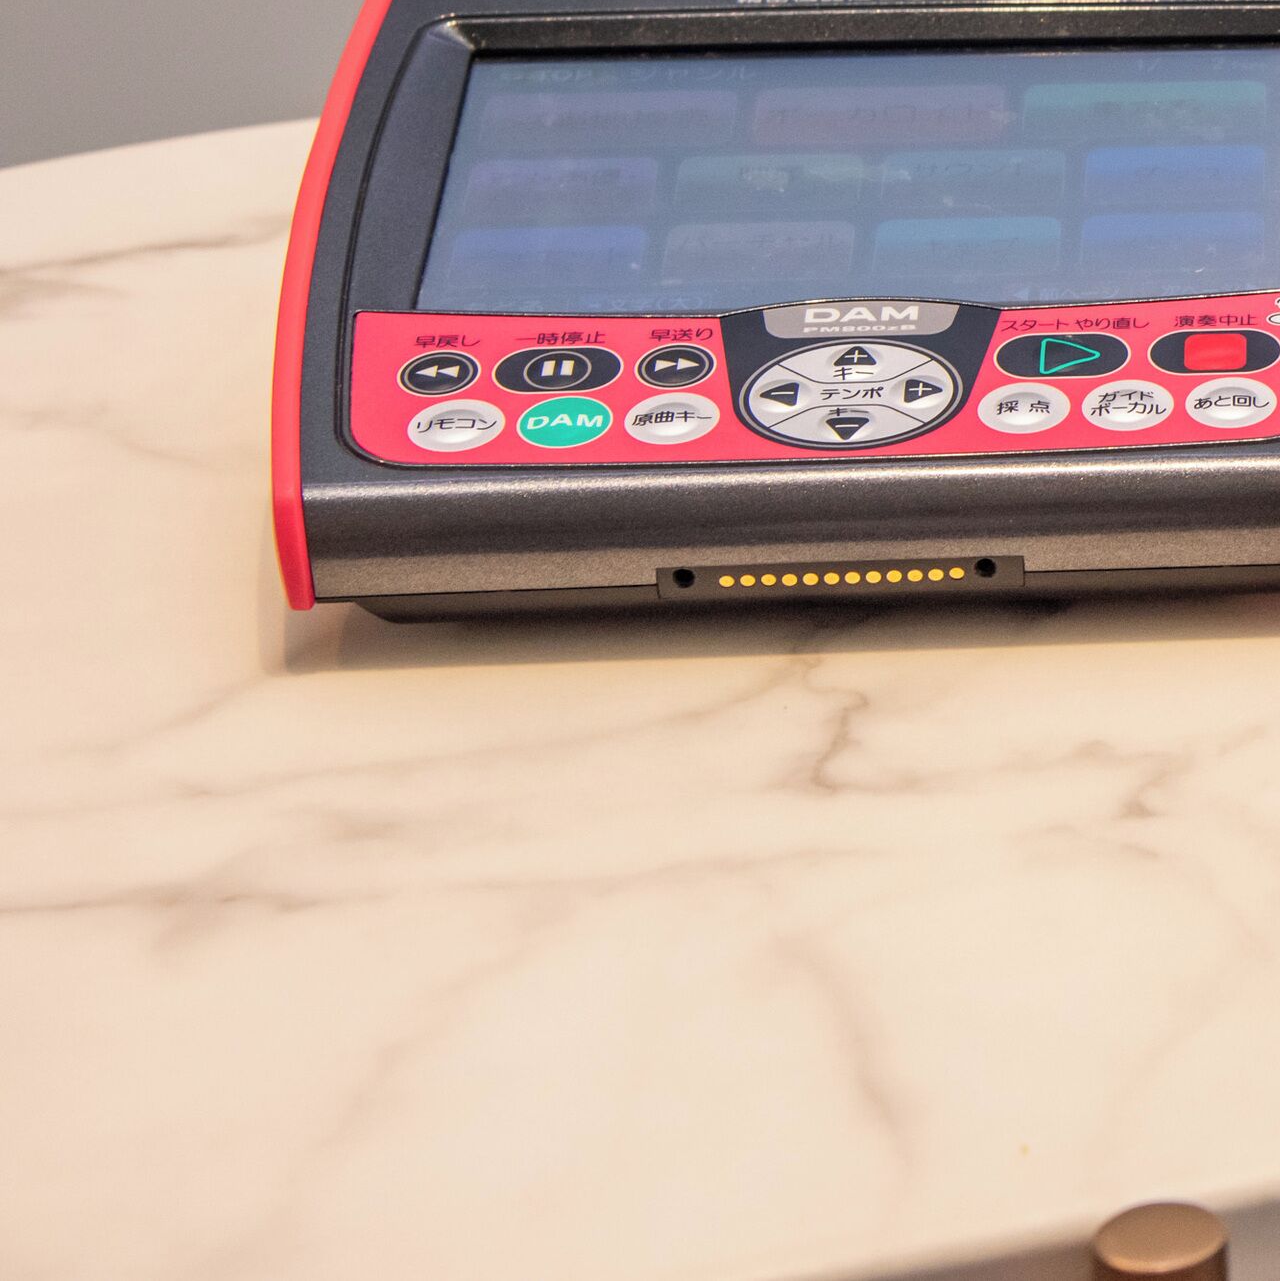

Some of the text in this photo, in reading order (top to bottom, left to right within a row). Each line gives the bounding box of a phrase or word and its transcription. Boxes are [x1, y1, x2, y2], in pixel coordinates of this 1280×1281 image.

[803, 305, 920, 324] DAM
[1174, 315, 1258, 328] 演奏中止
[1001, 317, 1151, 331] スタート やり直し
[414, 334, 481, 349] 早戻し
[515, 331, 607, 346] 一時停止
[648, 326, 714, 342] 早送り
[832, 366, 875, 381] キー
[820, 386, 884, 401] テンポ
[1098, 390, 1155, 402] ガイド
[1193, 393, 1270, 409] あと回し
[1090, 401, 1167, 416] ボーカル
[416, 417, 498, 432] リモコン
[526, 412, 604, 429] DAM
[631, 409, 714, 427] 原曲キー
